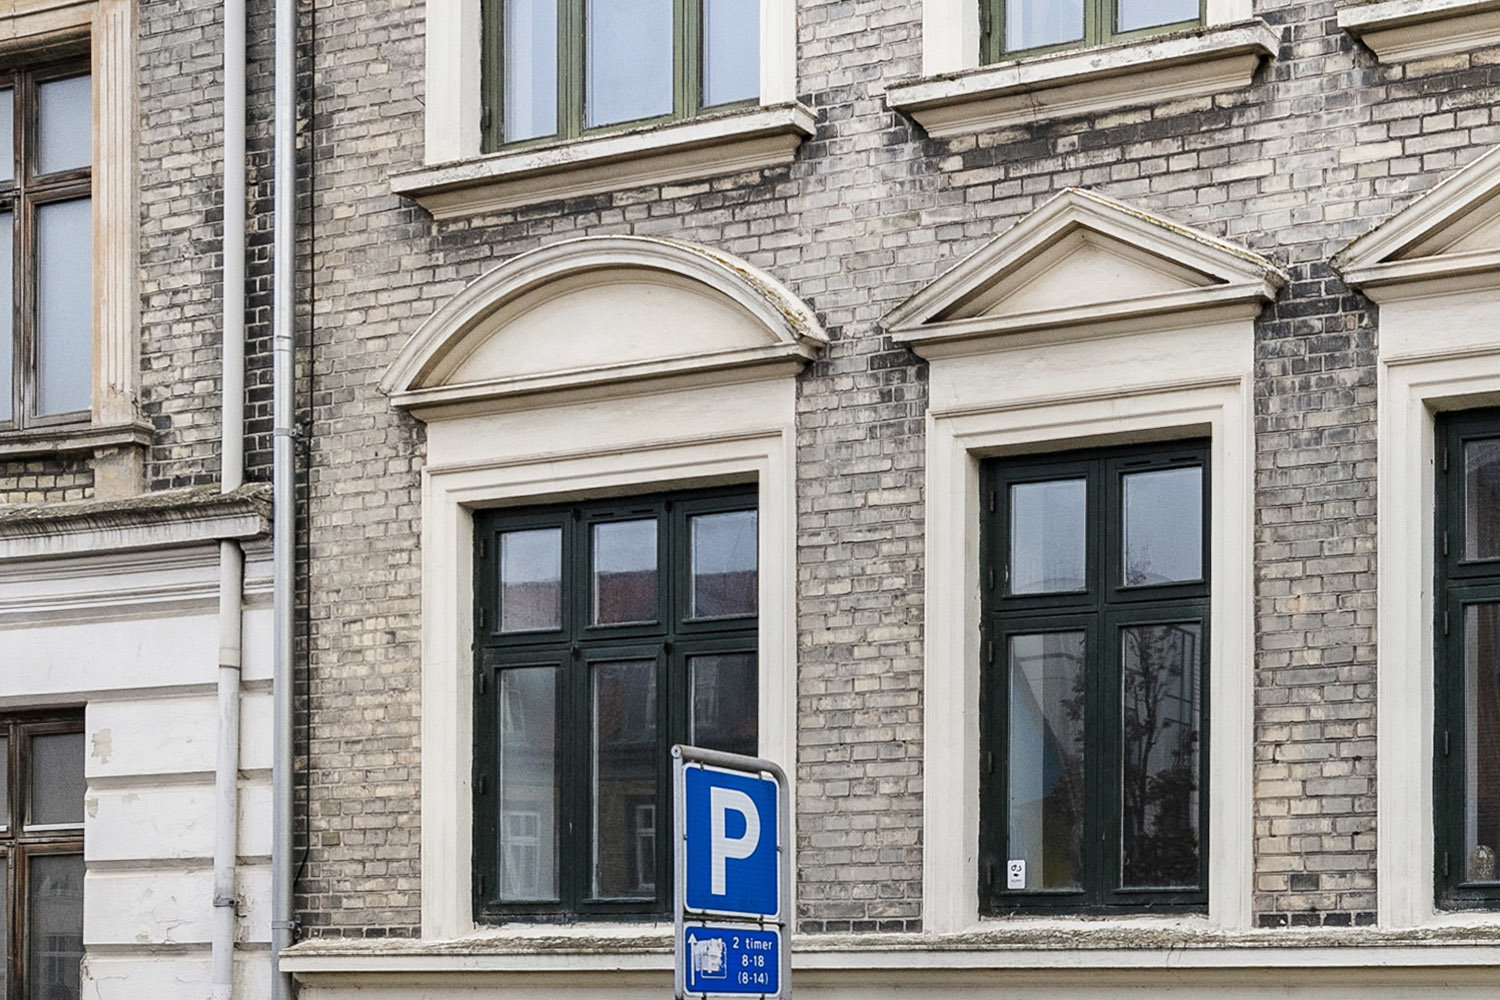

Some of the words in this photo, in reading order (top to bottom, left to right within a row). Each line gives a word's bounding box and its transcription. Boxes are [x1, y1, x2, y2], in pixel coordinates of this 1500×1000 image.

[710, 786, 761, 896] P
[732, 936, 740, 949] 2
[745, 937, 773, 951] timer
[741, 954, 765, 967] 8-18
[737, 971, 769, 985] (8-14)
